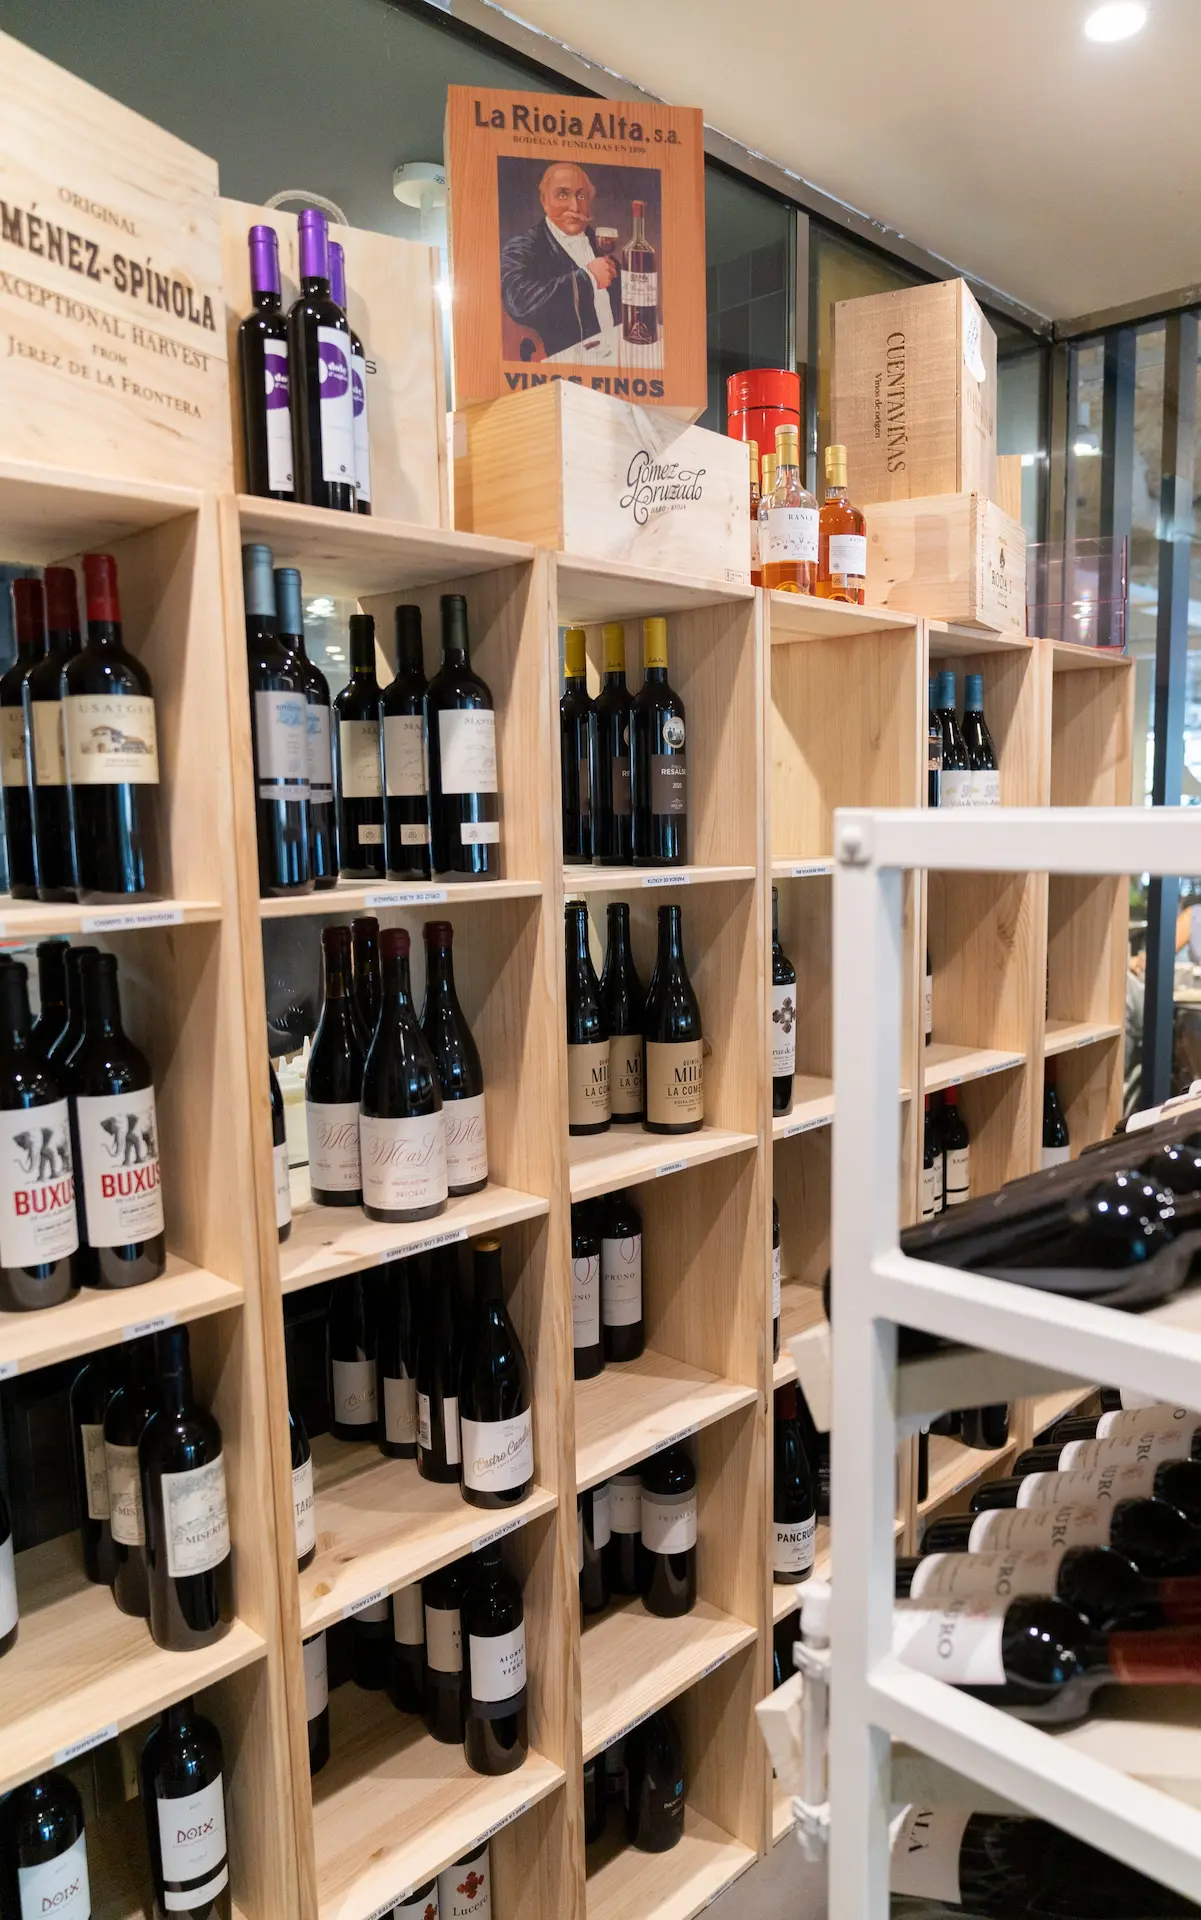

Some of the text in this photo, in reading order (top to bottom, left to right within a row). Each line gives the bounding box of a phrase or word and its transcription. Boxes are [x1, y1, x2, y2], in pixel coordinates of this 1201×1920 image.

[474, 100, 505, 129] La
[512, 104, 583, 137] Rioja
[512, 135, 559, 147] BODEGAS
[561, 140, 614, 152] FUNDADAS
[615, 145, 629, 153] EN
[58, 186, 140, 239] ORIGINAL
[92, 343, 128, 367] FROM
[131, 323, 210, 372] HARVEST
[68, 360, 92, 380] DE
[96, 369, 117, 389] LA
[120, 376, 202, 420] FRONTERA
[591, 377, 665, 398] FINOS
[873, 373, 883, 439] Vinos de origen
[886, 331, 908, 472] CUENTAVIÑAS
[585, 1087, 596, 1096] LA
[619, 1078, 631, 1087] LA
[667, 1087, 679, 1097] LA
[386, 1232, 460, 1258] PAGO DE LOS CAPELLANES
[494, 1529, 502, 1537] DO
[502, 1521, 516, 1533] BOCA
[478, 1533, 494, 1546] DEMO
[351, 1591, 382, 1611] BASTARDA
[452, 1894, 489, 1917] Lucero
